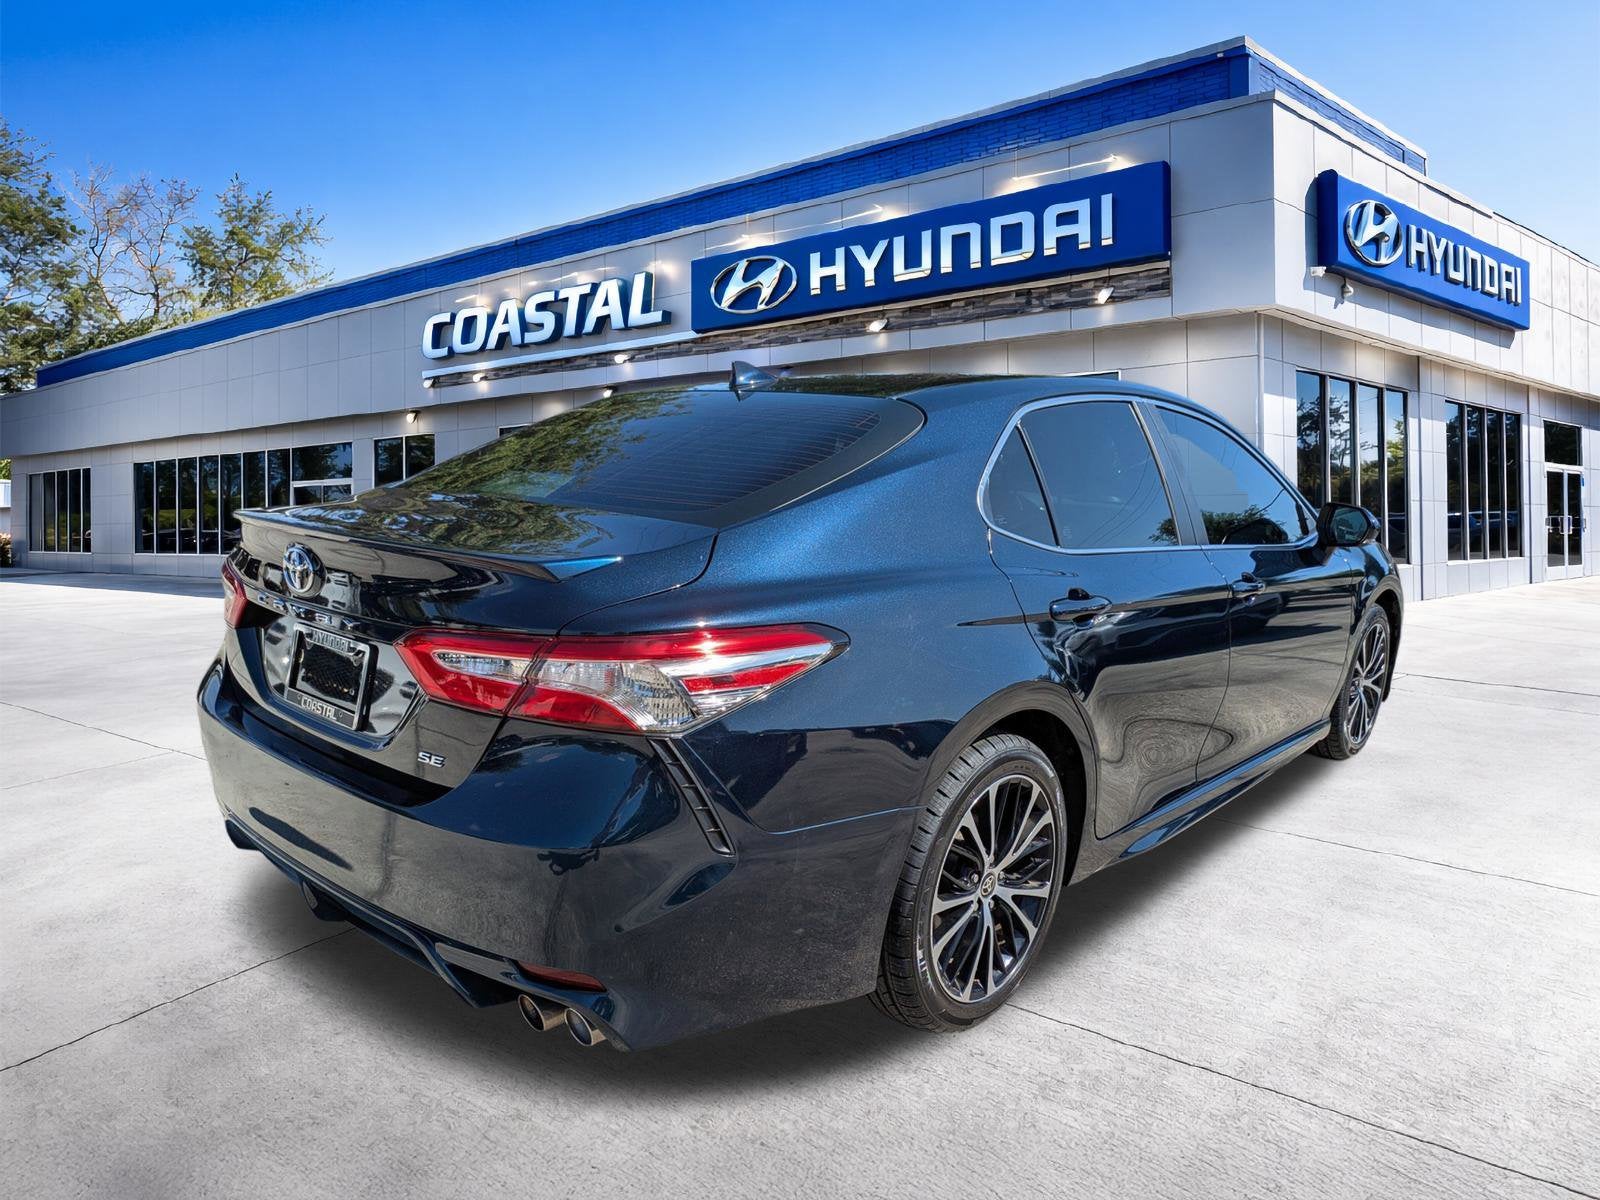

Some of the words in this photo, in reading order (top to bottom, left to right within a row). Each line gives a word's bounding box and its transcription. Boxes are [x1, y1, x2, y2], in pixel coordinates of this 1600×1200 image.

[810, 193, 1113, 295] HYUNDAI
[1405, 224, 1522, 306] HYUNDAI
[422, 271, 667, 359] COASTAL
[301, 695, 337, 720] COASTAL
[418, 751, 446, 768] SE
